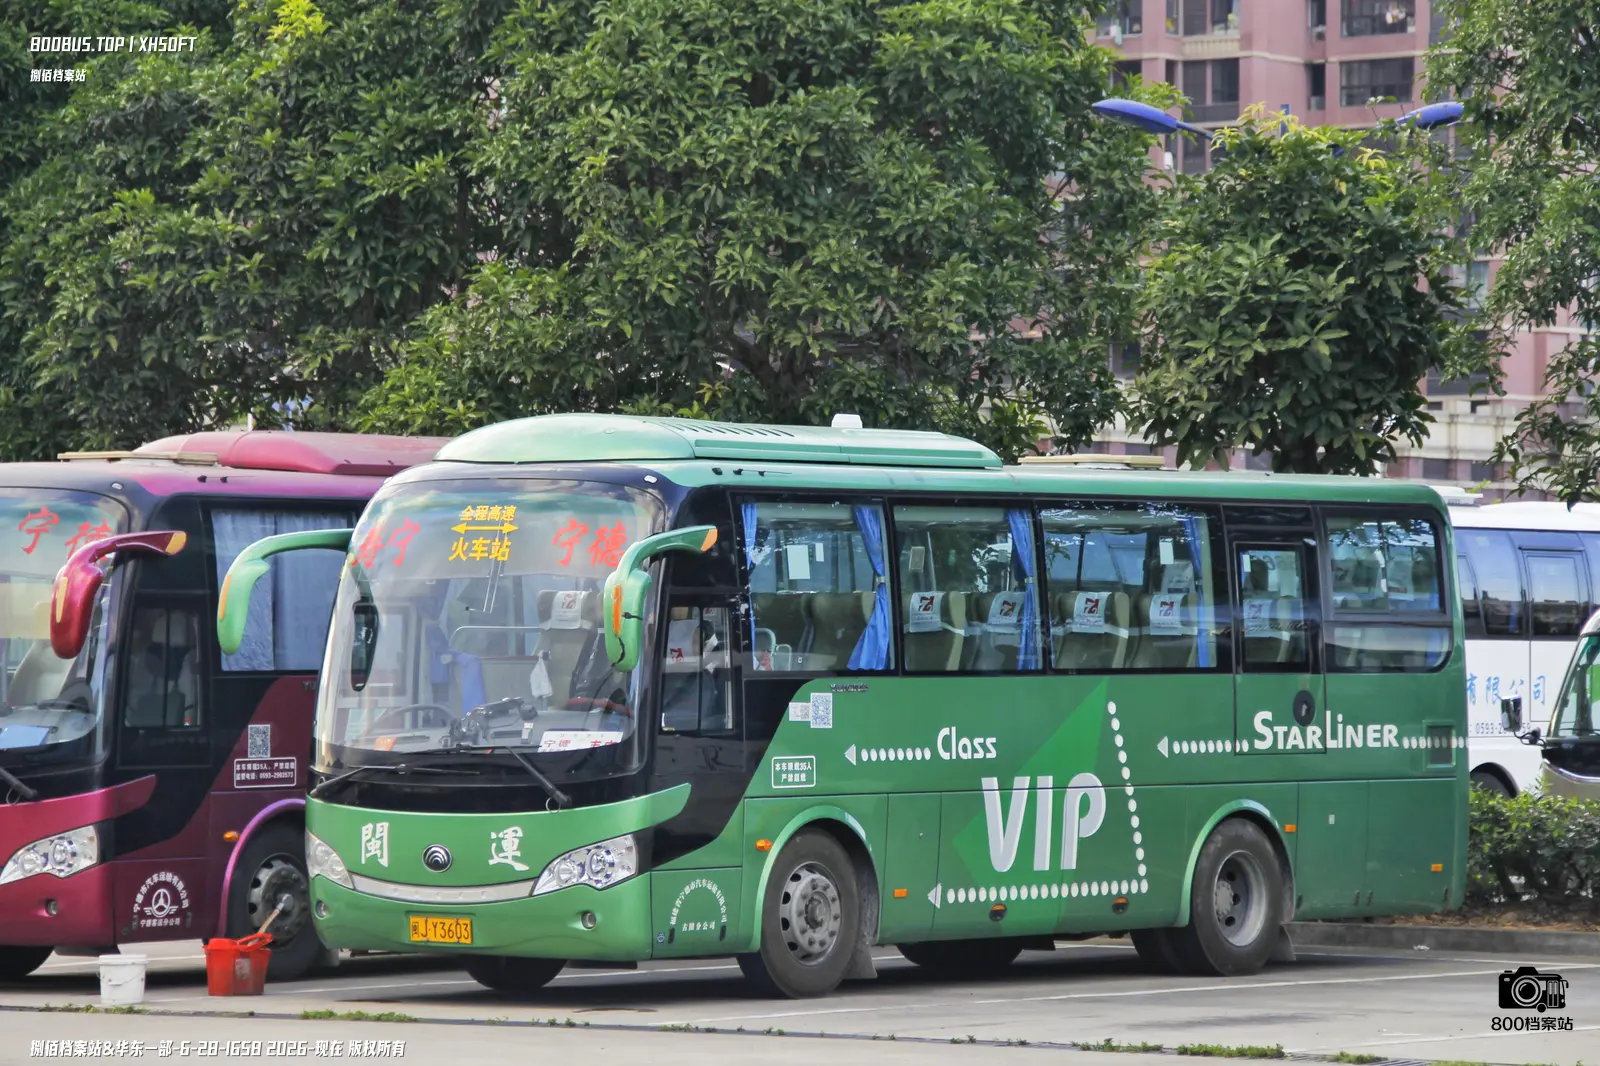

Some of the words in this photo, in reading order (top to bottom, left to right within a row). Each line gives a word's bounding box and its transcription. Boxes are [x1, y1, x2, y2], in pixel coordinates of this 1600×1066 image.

[459, 505, 517, 521] 全程高速
[448, 537, 512, 561] 火车站
[552, 518, 628, 568] 宁德
[937, 726, 997, 760] Class
[981, 772, 1107, 872] VIP
